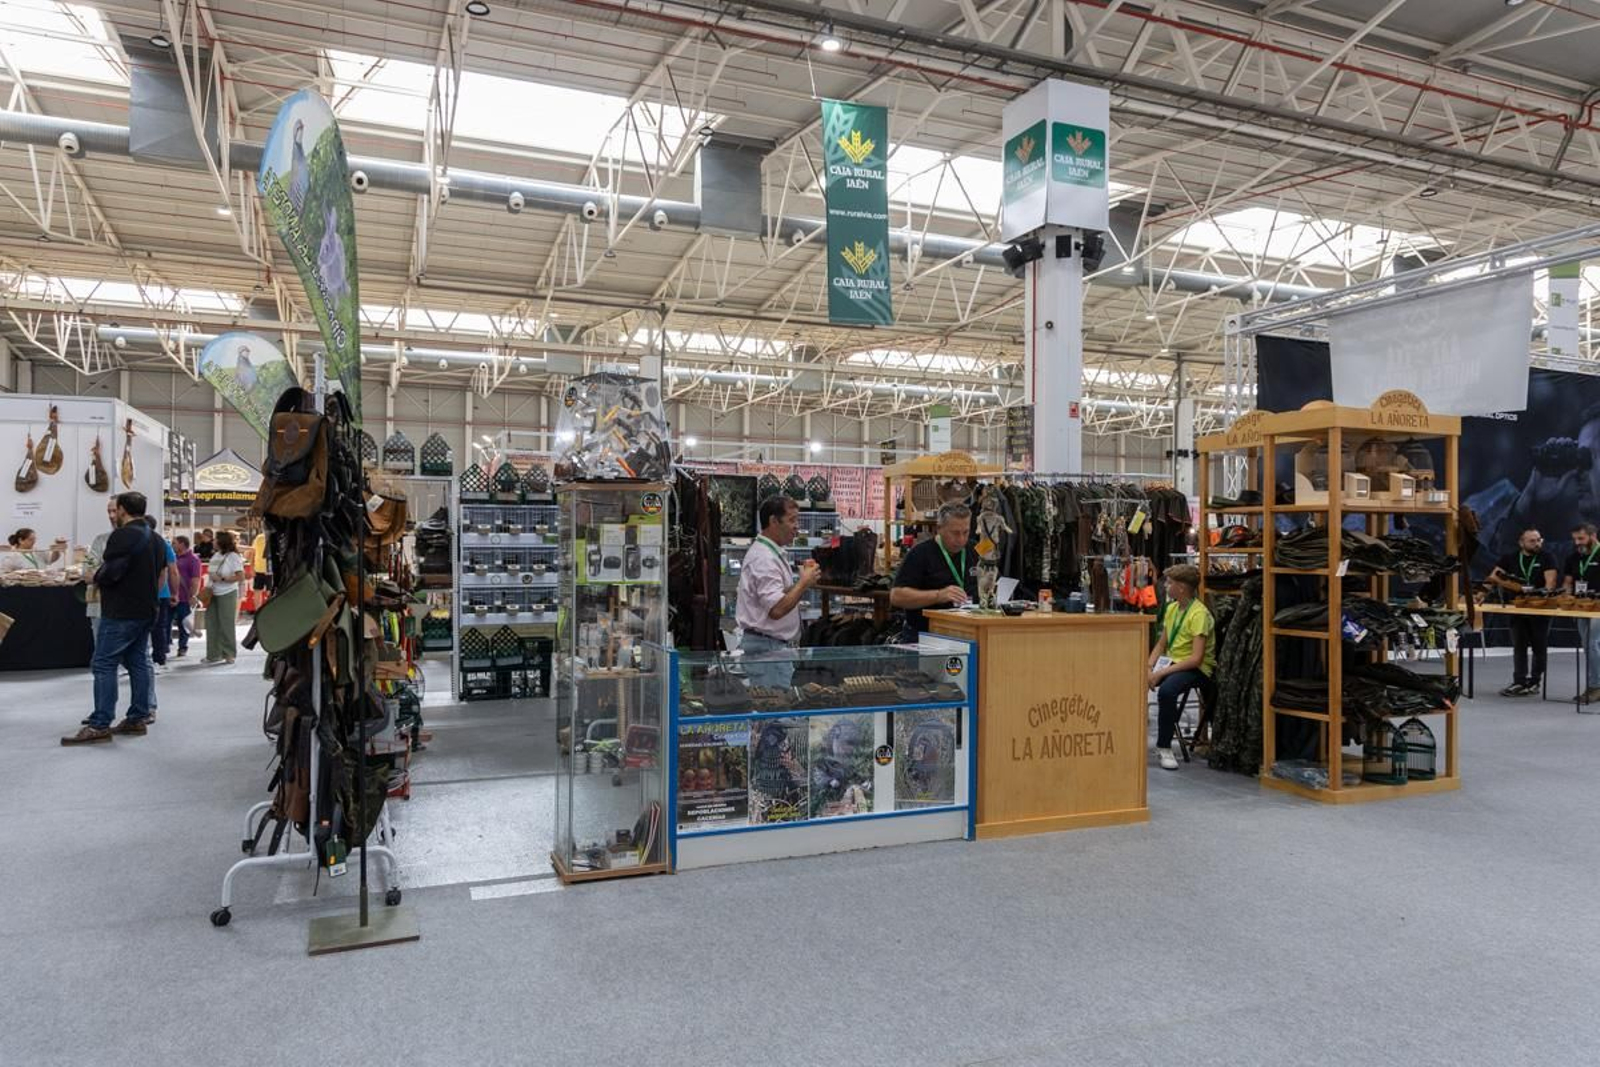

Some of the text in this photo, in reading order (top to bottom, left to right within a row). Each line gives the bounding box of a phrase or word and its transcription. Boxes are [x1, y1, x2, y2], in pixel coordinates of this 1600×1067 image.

[1075, 157, 1104, 170] RURAL
[853, 167, 885, 180] RURAL
[856, 278, 888, 289] RURAL
[1371, 410, 1429, 429] LA AÑORETA
[1028, 694, 1101, 728] Cinegética
[1012, 729, 1114, 761] LA AÑORETA
